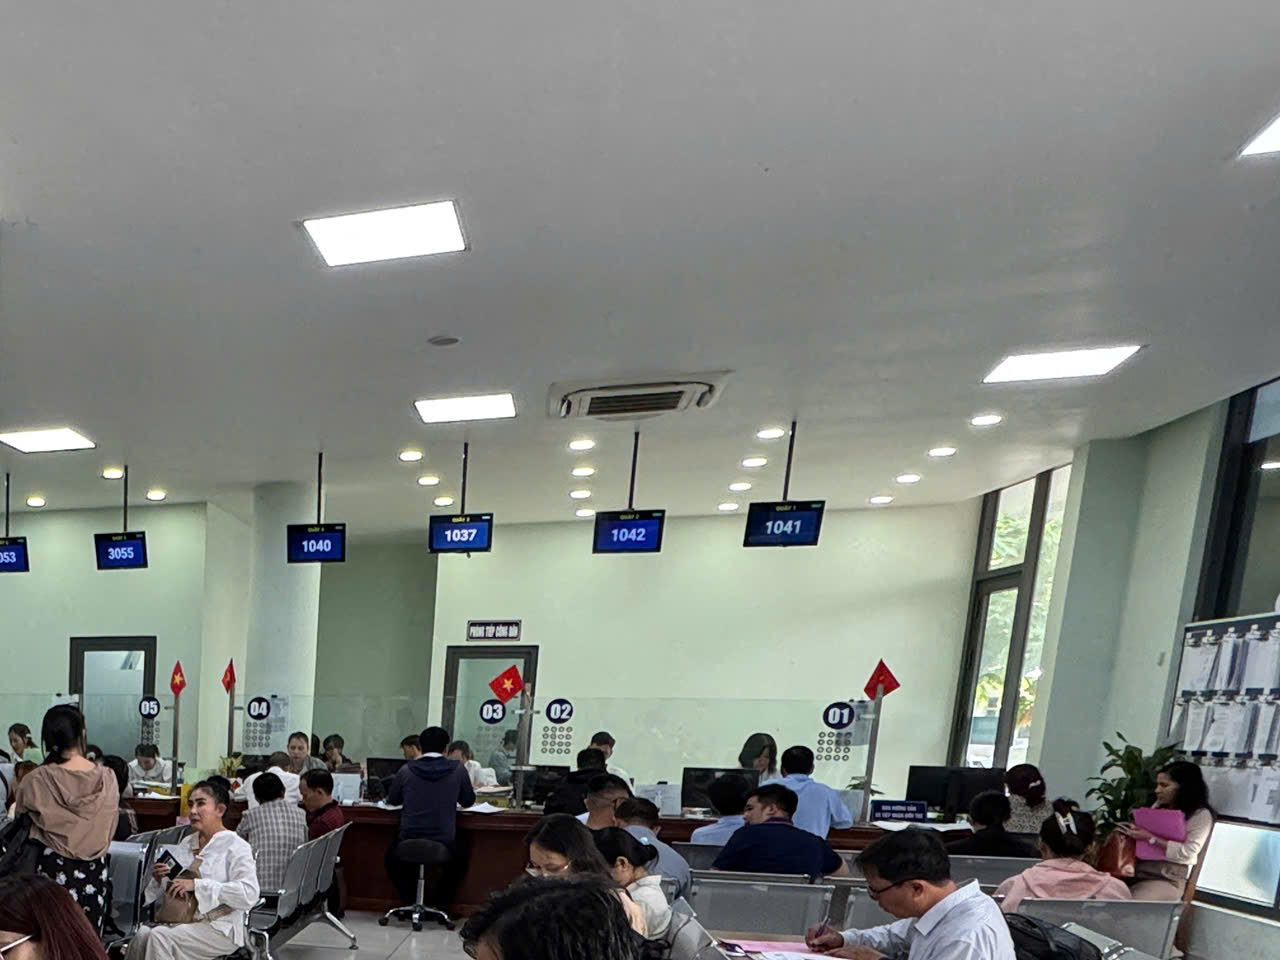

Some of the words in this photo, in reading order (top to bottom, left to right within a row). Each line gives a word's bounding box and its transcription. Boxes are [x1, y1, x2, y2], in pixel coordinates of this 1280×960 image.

[765, 520, 801, 535] 1041
[444, 529, 478, 542] 1037
[611, 528, 646, 542] 1042
[108, 547, 135, 560] 3055
[301, 540, 332, 553] 1040
[141, 701, 158, 715] 05
[250, 701, 268, 716] 04
[482, 704, 503, 719] 03
[550, 704, 571, 719] 02
[828, 707, 850, 724] 01
